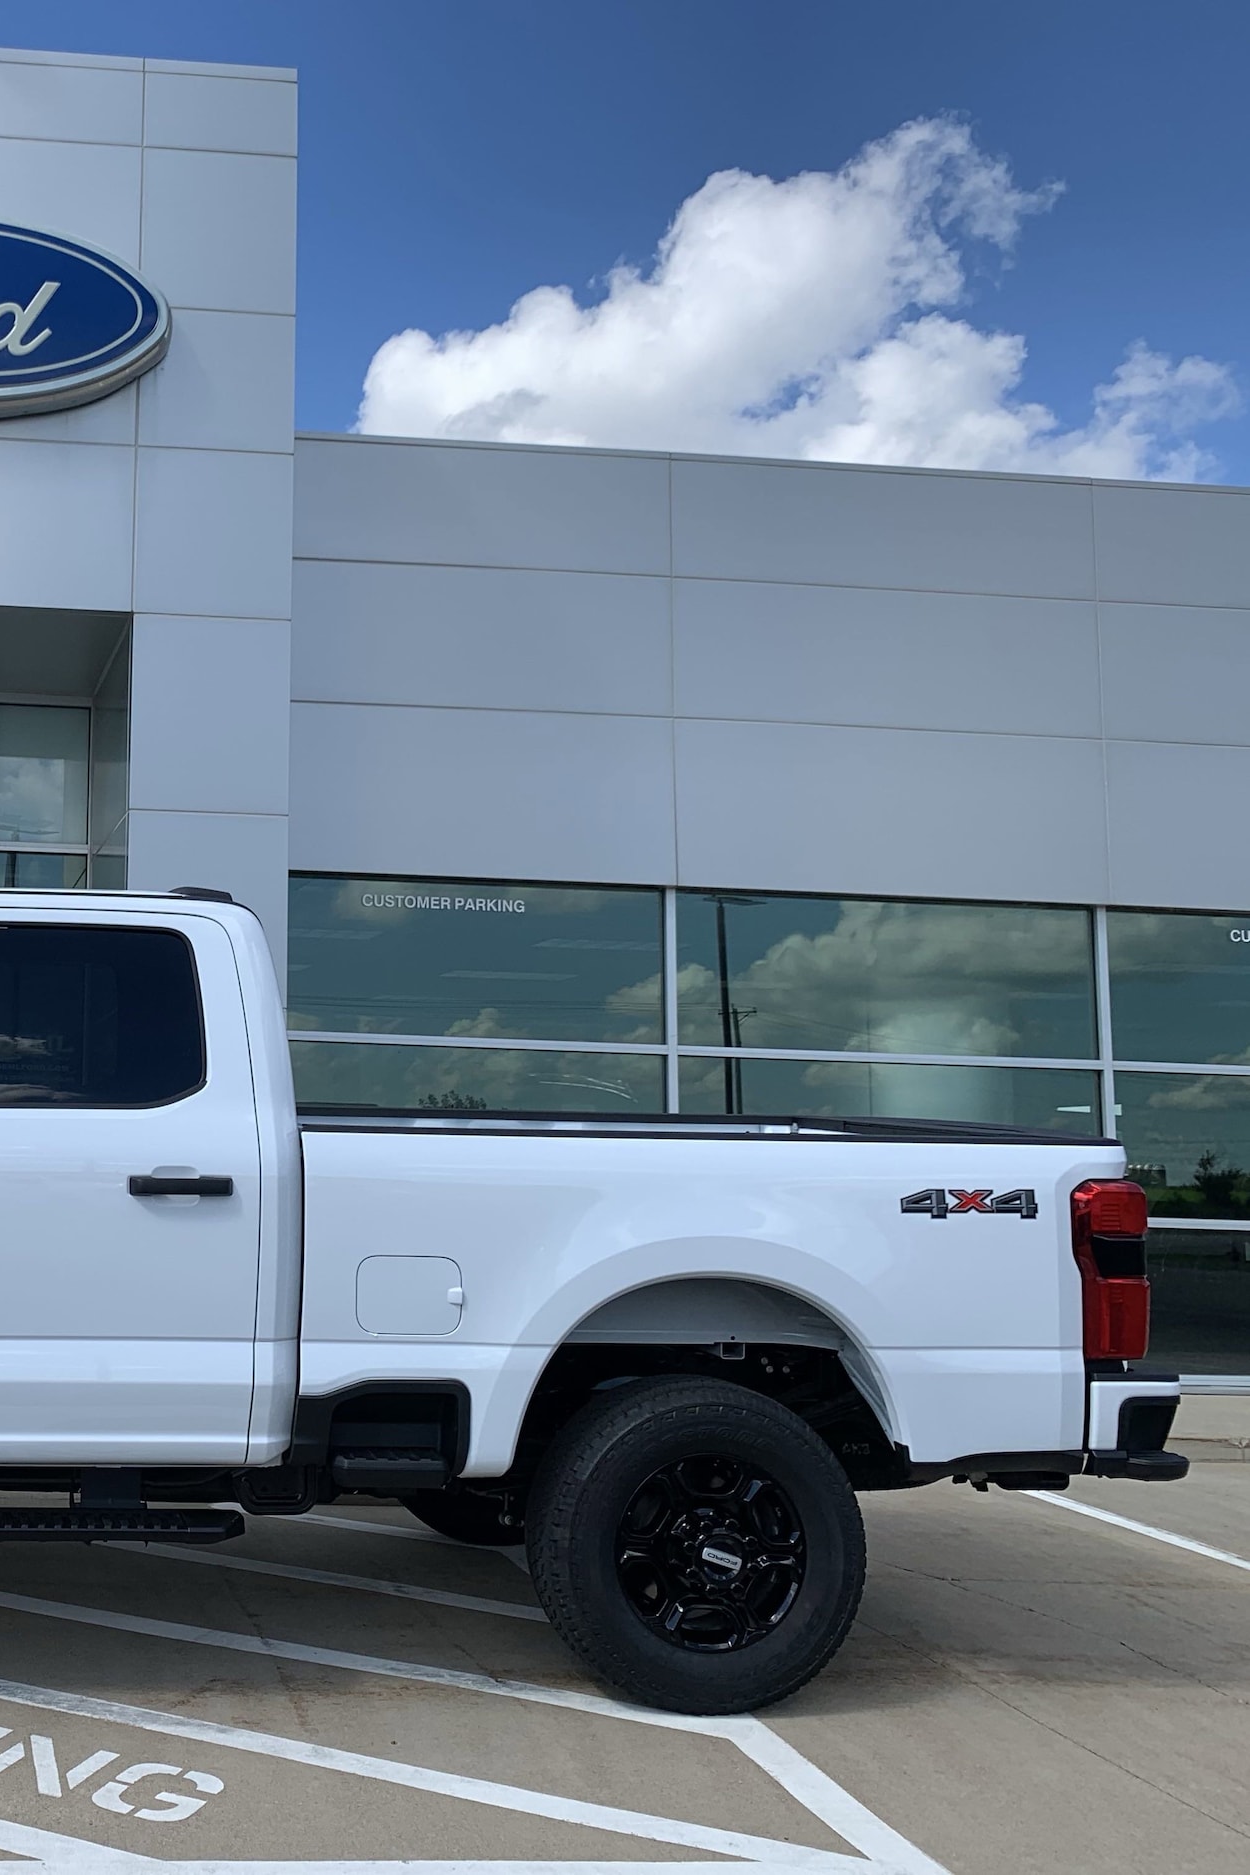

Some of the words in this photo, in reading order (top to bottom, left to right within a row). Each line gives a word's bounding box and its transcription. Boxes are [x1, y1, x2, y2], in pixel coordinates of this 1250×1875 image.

[362, 894, 451, 910] CUSTOMER
[454, 898, 526, 913] PARKING
[706, 1552, 739, 1567] FORD
